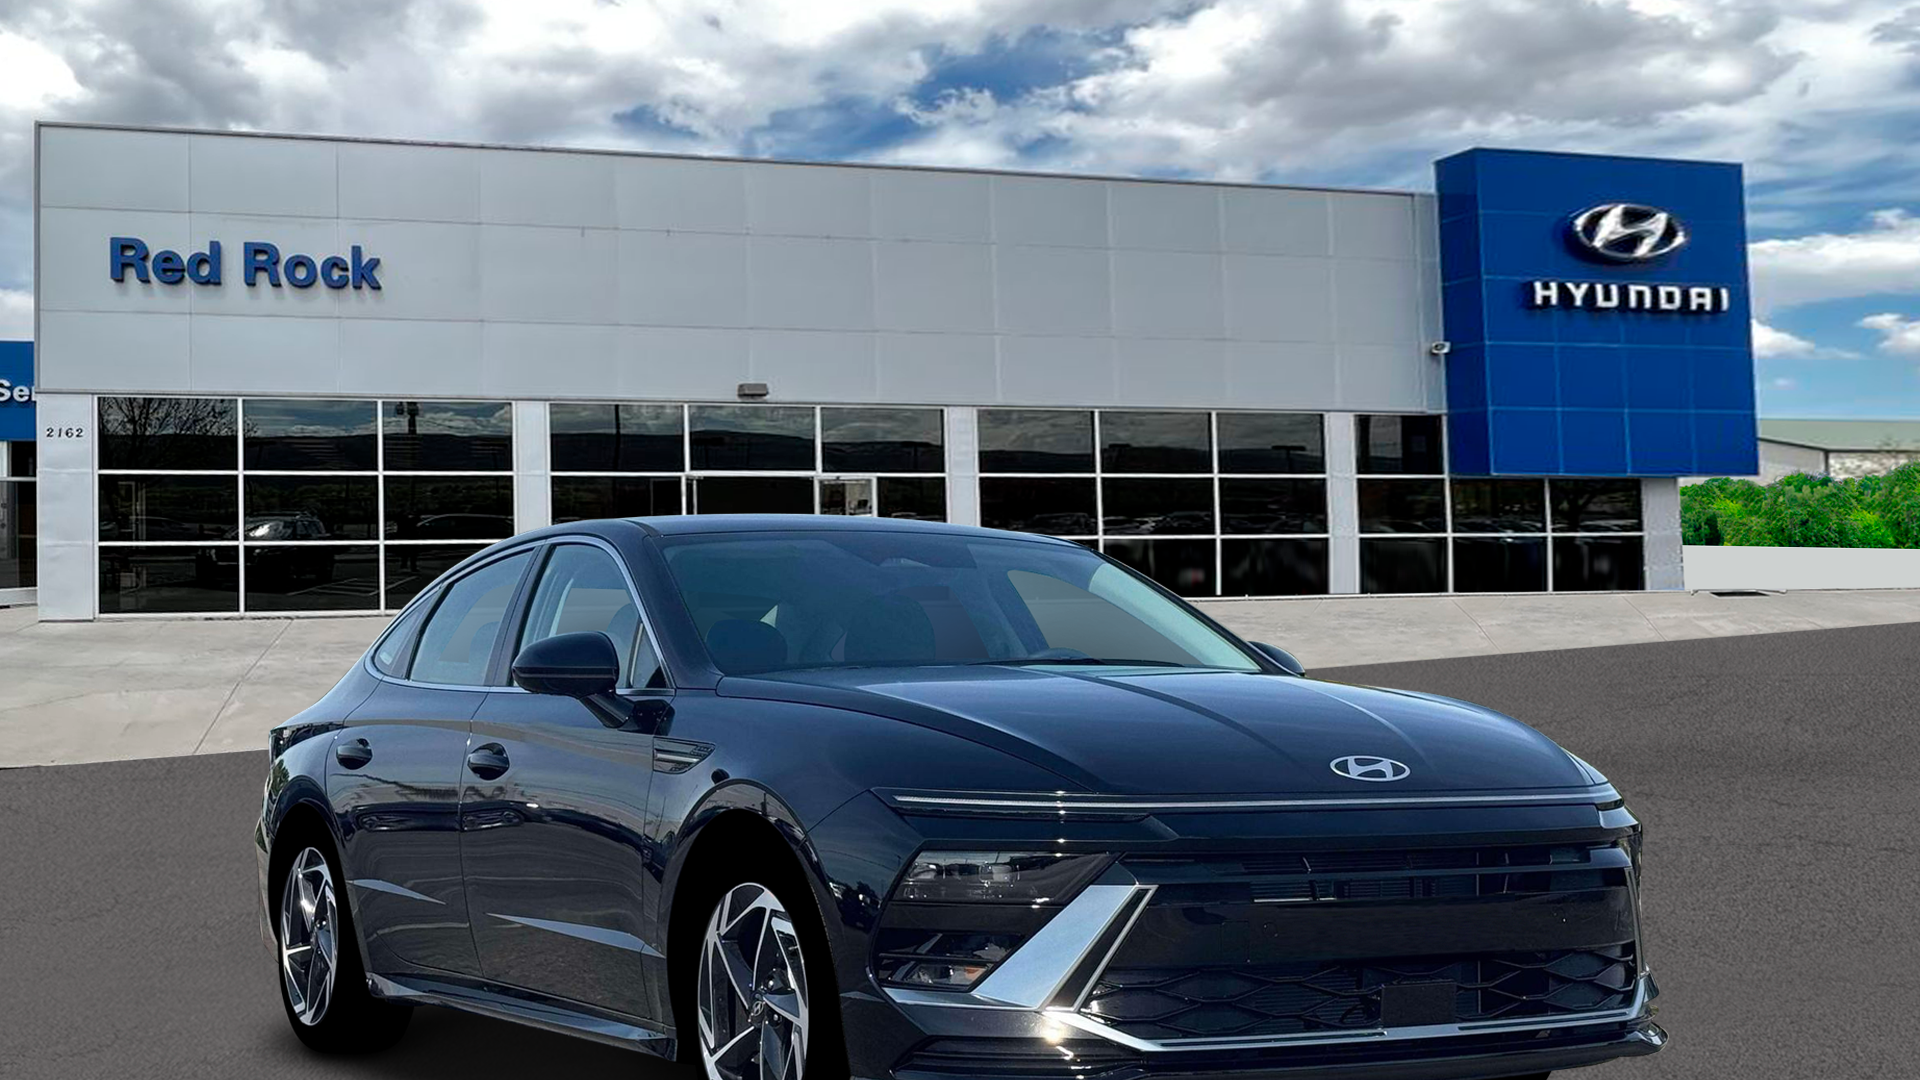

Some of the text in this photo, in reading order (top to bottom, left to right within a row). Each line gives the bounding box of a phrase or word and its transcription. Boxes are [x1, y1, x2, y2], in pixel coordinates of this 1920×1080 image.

[110, 237, 382, 290] Red Rock
[1534, 280, 1729, 311] HYUNDAI
[46, 427, 84, 438] 2162
